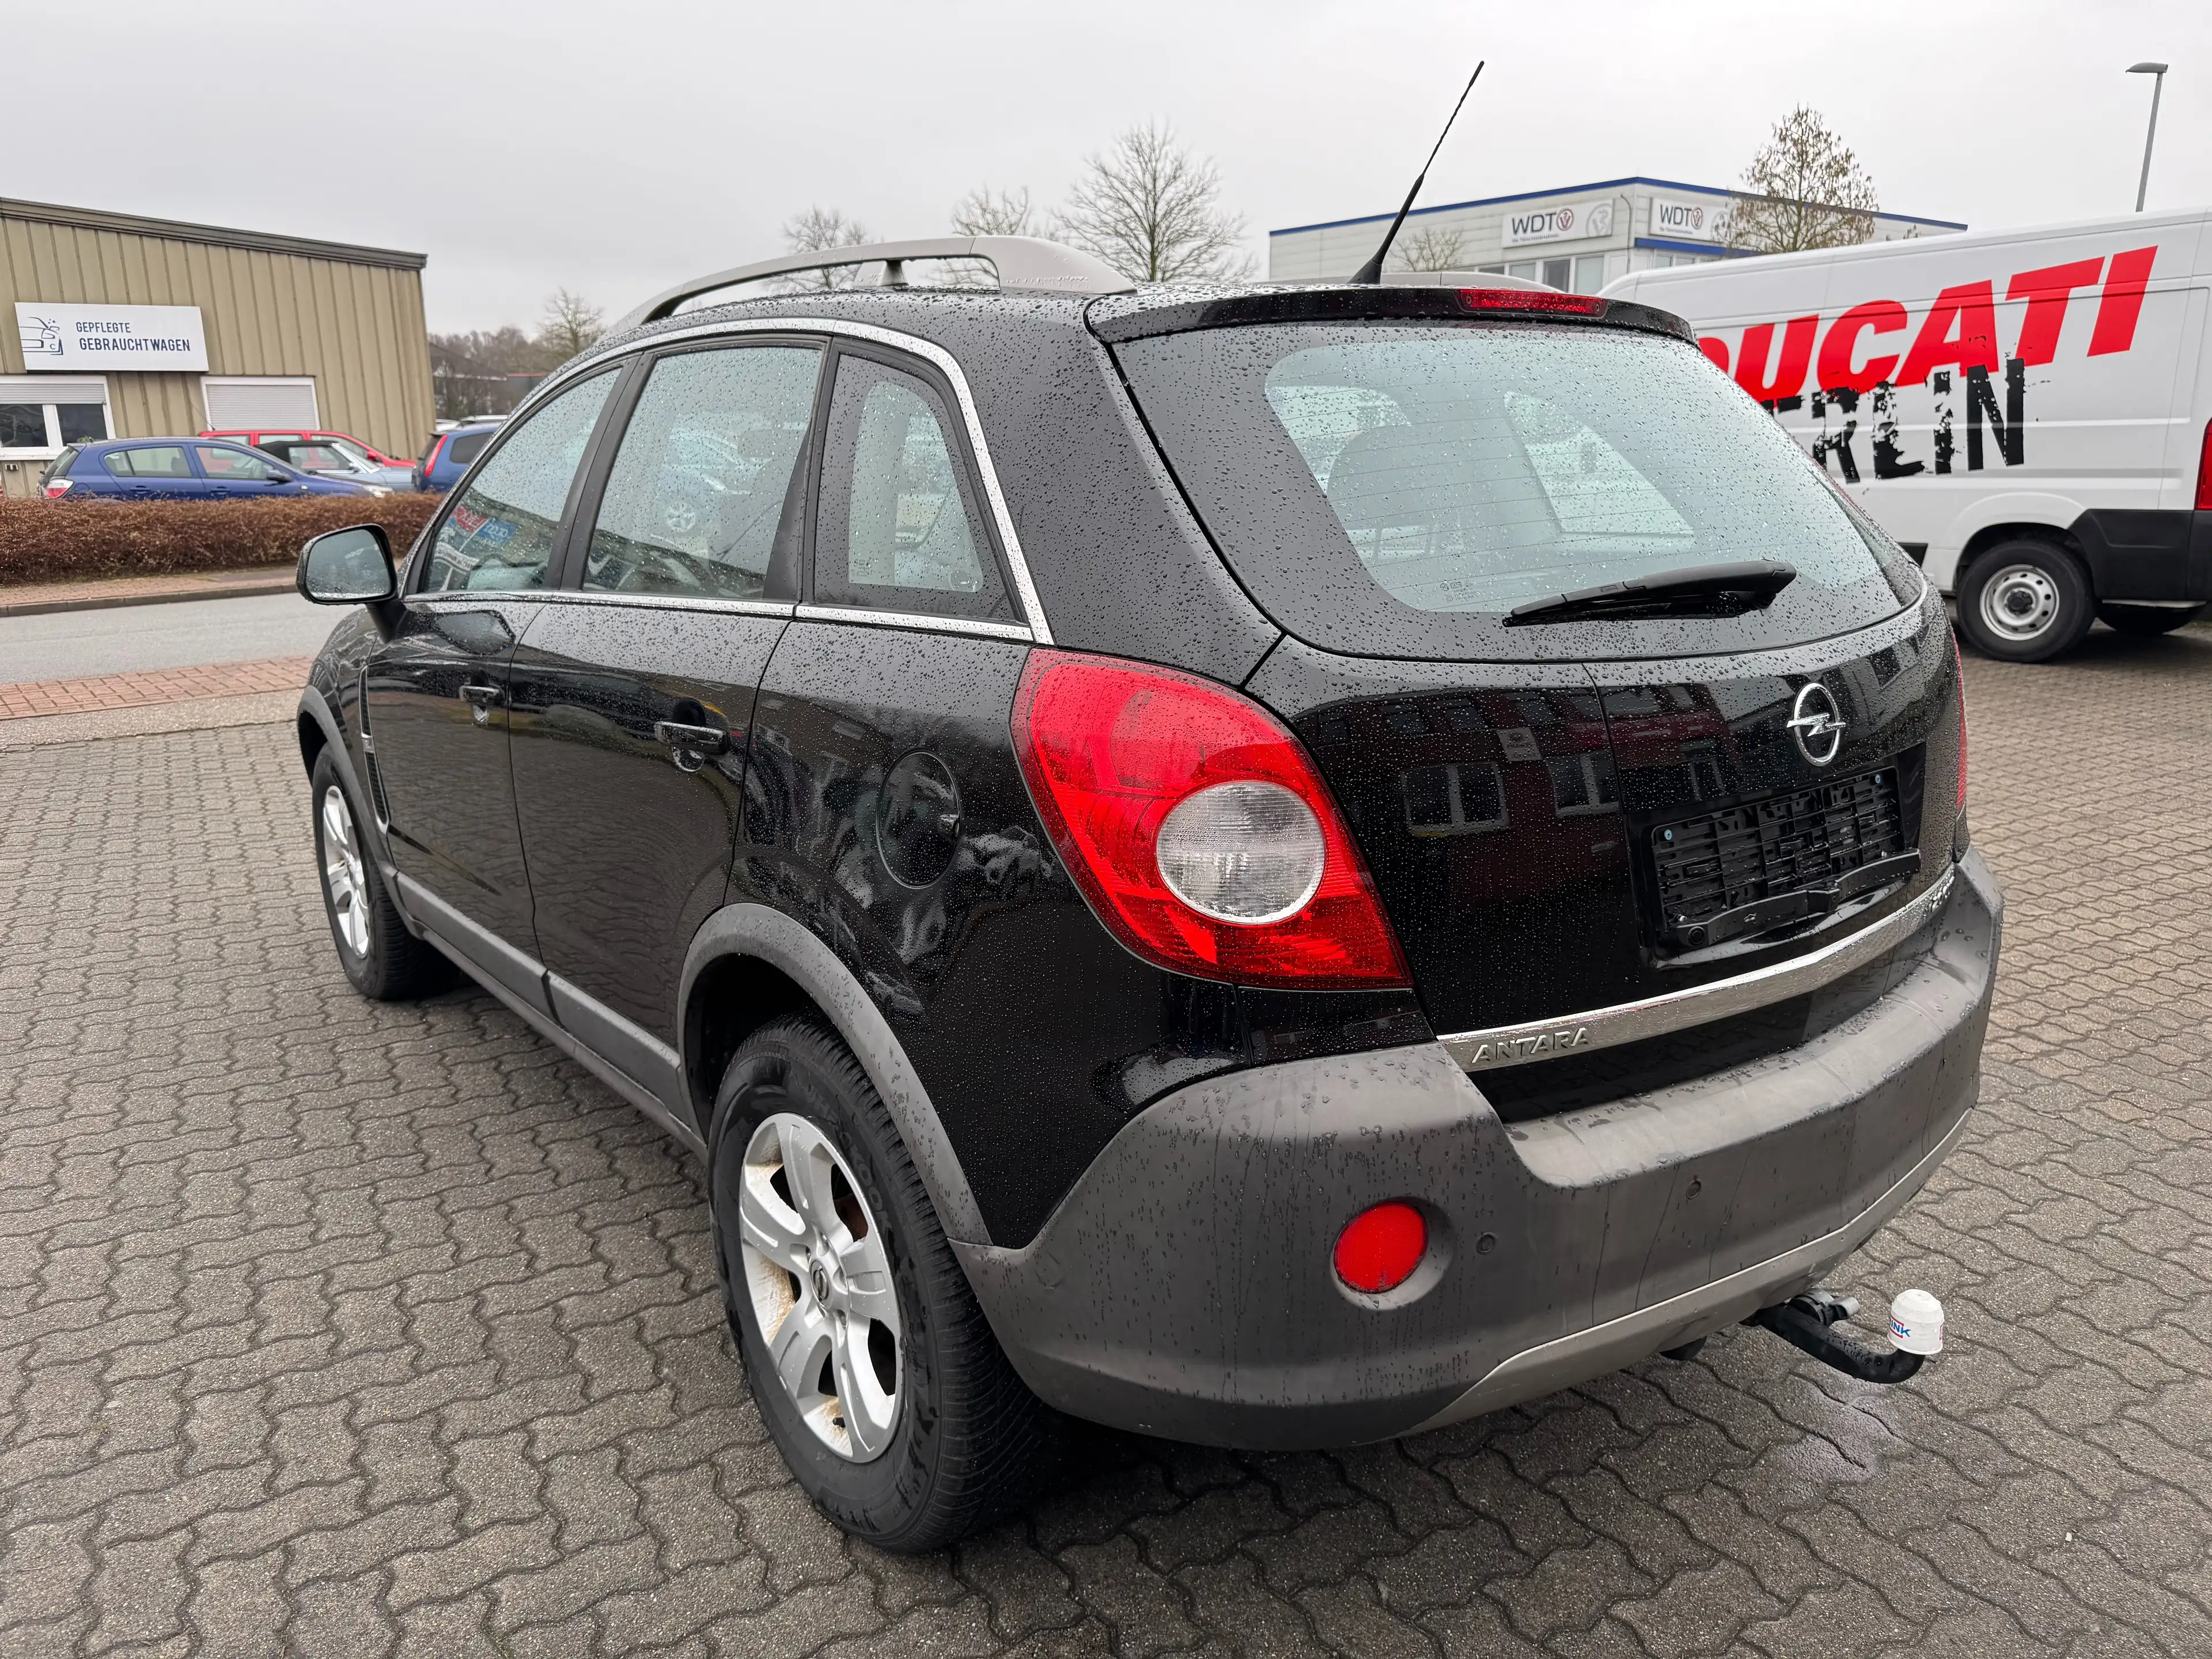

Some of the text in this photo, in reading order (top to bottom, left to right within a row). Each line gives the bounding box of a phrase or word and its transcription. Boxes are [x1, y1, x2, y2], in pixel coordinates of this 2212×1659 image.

[1512, 212, 1556, 235] WDT
[1660, 204, 1692, 227] WDT
[75, 321, 131, 333] GEPFLEGTE
[79, 338, 191, 351] GEBRAUCHTWAGEN
[1760, 358, 2025, 483] RLIN
[1471, 1027, 1592, 1063] ANTARA
[1890, 1320, 1911, 1338] INK
